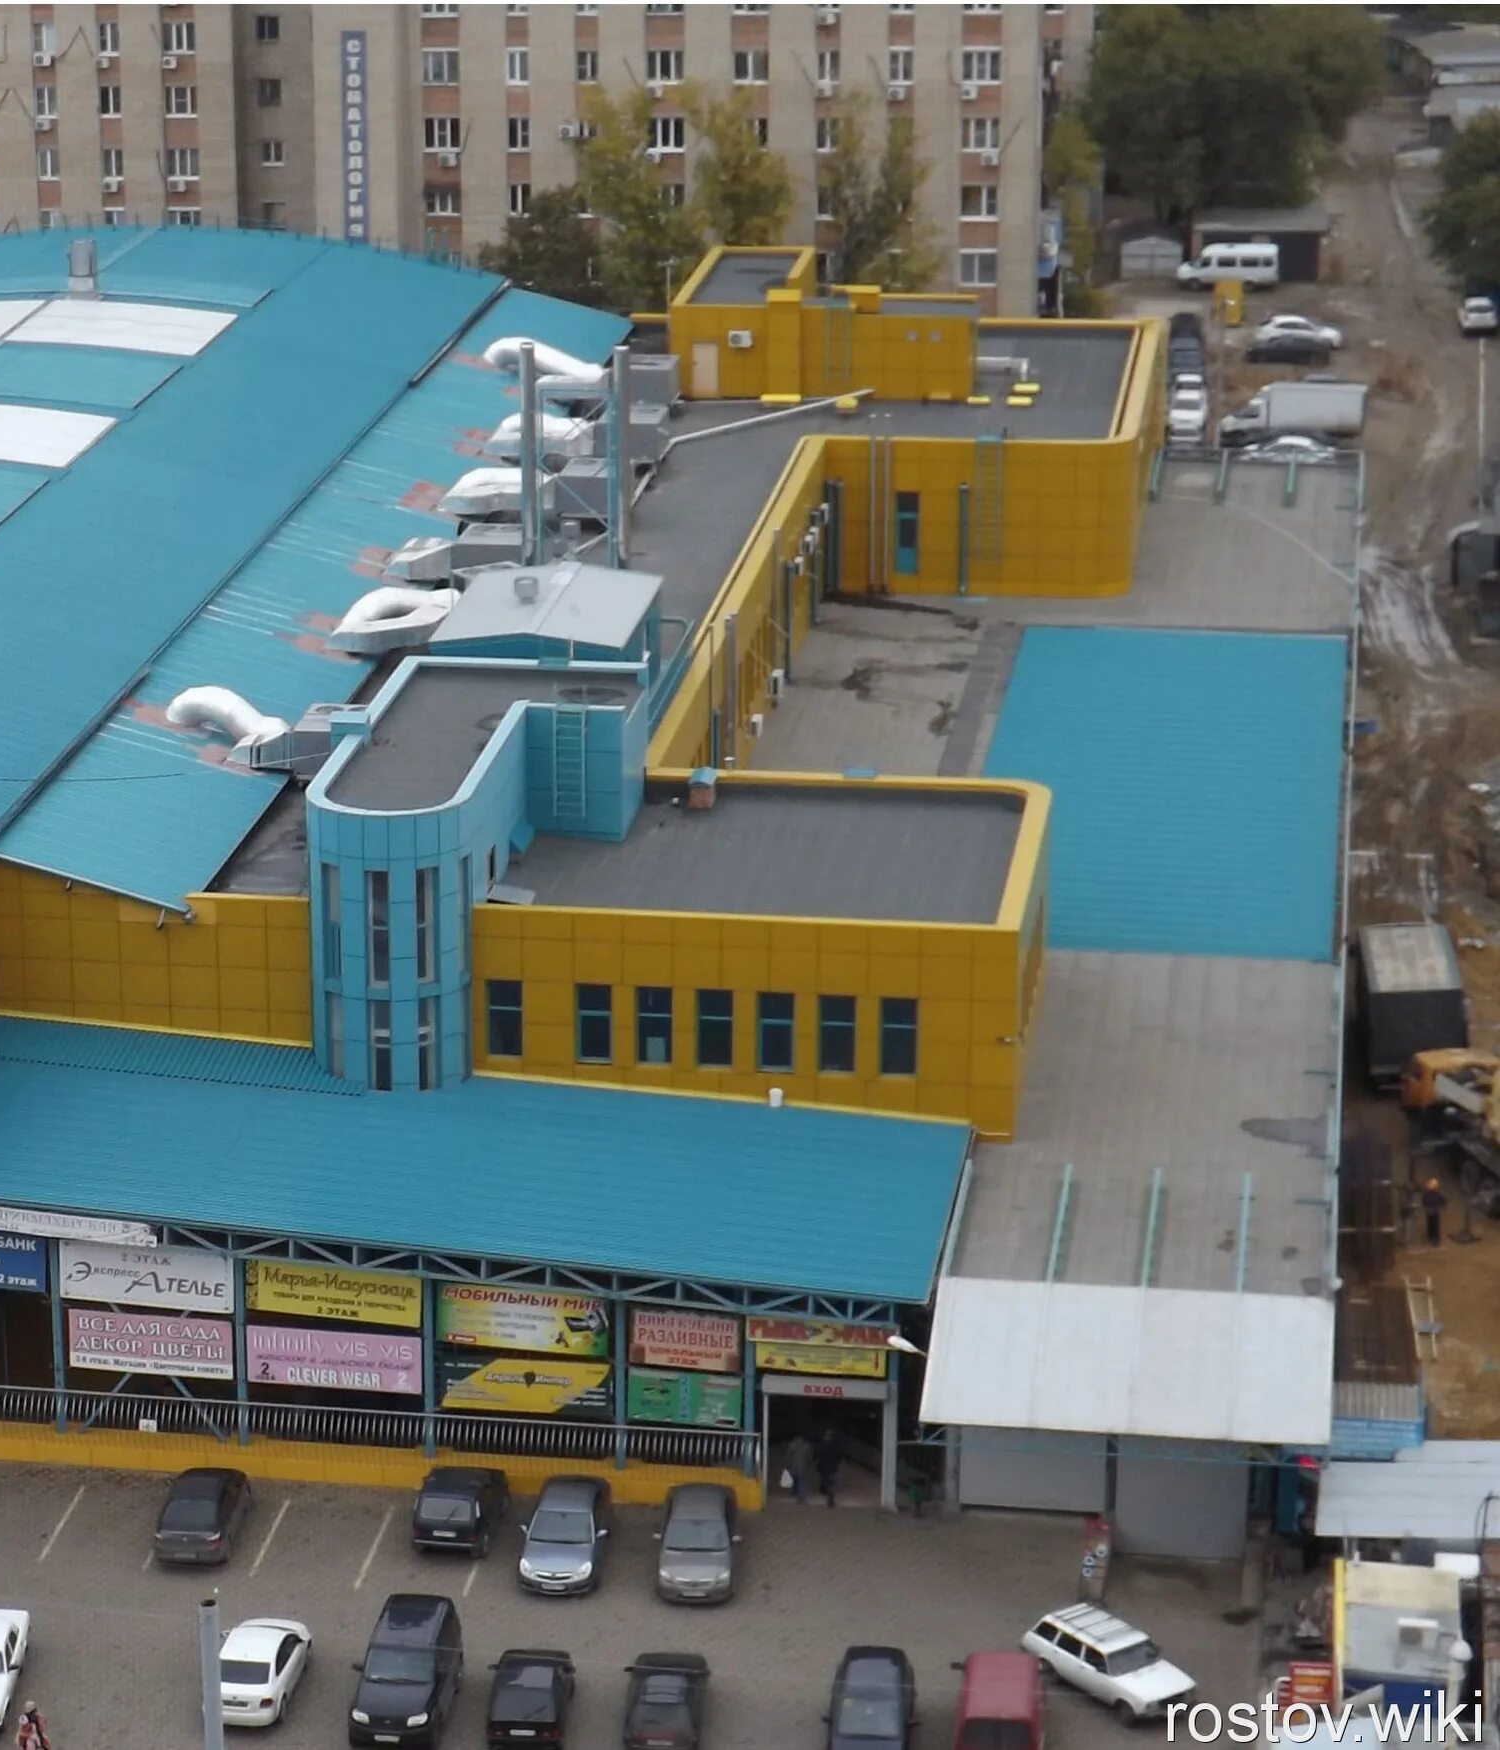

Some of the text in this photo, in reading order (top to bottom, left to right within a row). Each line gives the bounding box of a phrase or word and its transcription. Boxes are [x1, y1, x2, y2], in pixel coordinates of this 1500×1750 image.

[346, 39, 365, 237] СТОМАТОЛОГИЯ
[66, 1261, 140, 1282] Экспресс
[6, 1276, 37, 1287] этаж
[326, 1307, 359, 1317] ЭТАЖ
[563, 1298, 603, 1312] МИР
[78, 1316, 221, 1340] ВСЕ ДЛЯ САДА
[638, 1328, 733, 1349] РАЗЛИВНЫЕ
[153, 1343, 223, 1360] ЦВЕТЫ
[261, 1362, 269, 1376] 2
[287, 1367, 381, 1388] CLEVER WEAR
[397, 1372, 409, 1386] 2
[803, 1384, 844, 1397] ВХОД
